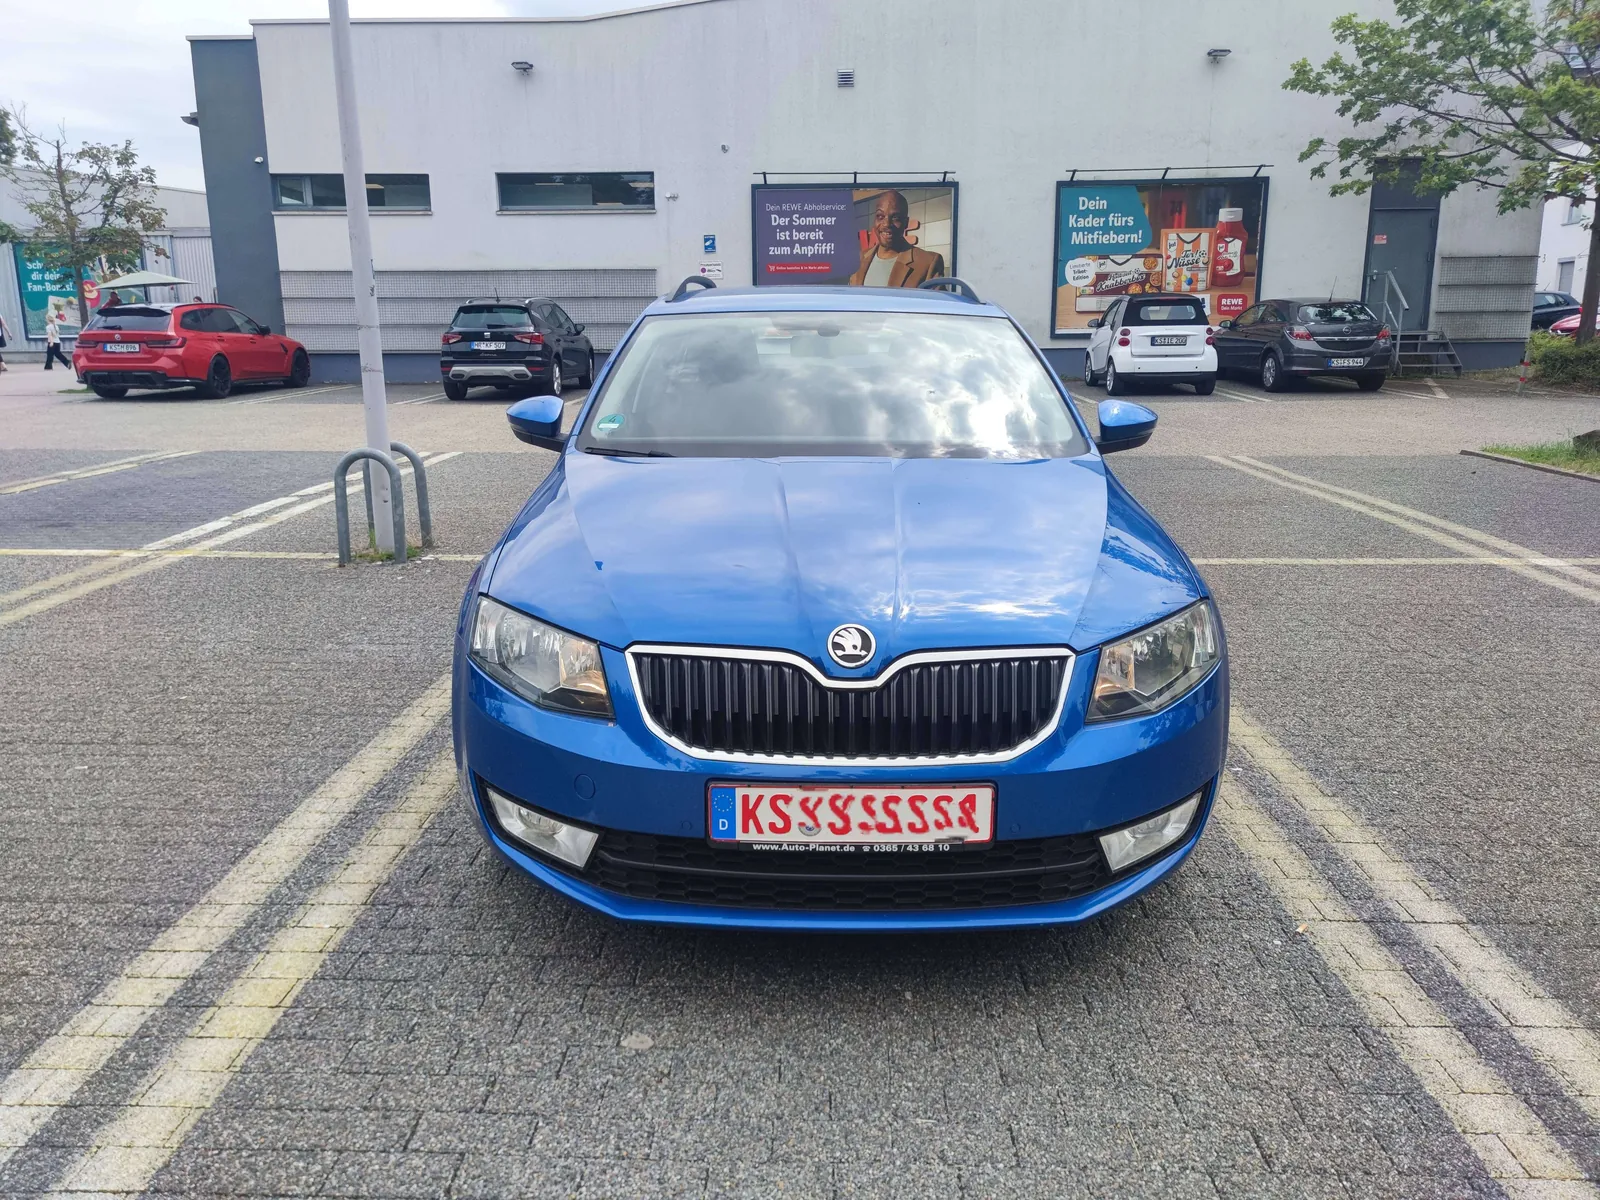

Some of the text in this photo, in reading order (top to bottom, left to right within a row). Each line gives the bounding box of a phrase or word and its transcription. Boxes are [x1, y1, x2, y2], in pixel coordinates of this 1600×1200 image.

[765, 202, 847, 211] Dein REWE Abholservice:
[1078, 196, 1107, 210] Dein
[771, 214, 837, 226] Der Sommer
[1068, 213, 1134, 228] Kader fürs
[776, 228, 824, 240] ist bereit
[1071, 229, 1143, 245] Mitfiebern!
[768, 243, 835, 257] zum Anpfiff!
[31, 271, 42, 280] dir
[608, 415, 617, 424] 4
[718, 819, 728, 831] D
[752, 843, 855, 852] www.Auto-Planet.de
[873, 844, 898, 852] 0365
[906, 844, 919, 852] 43
[922, 844, 935, 852] 68
[938, 843, 950, 851] 10
